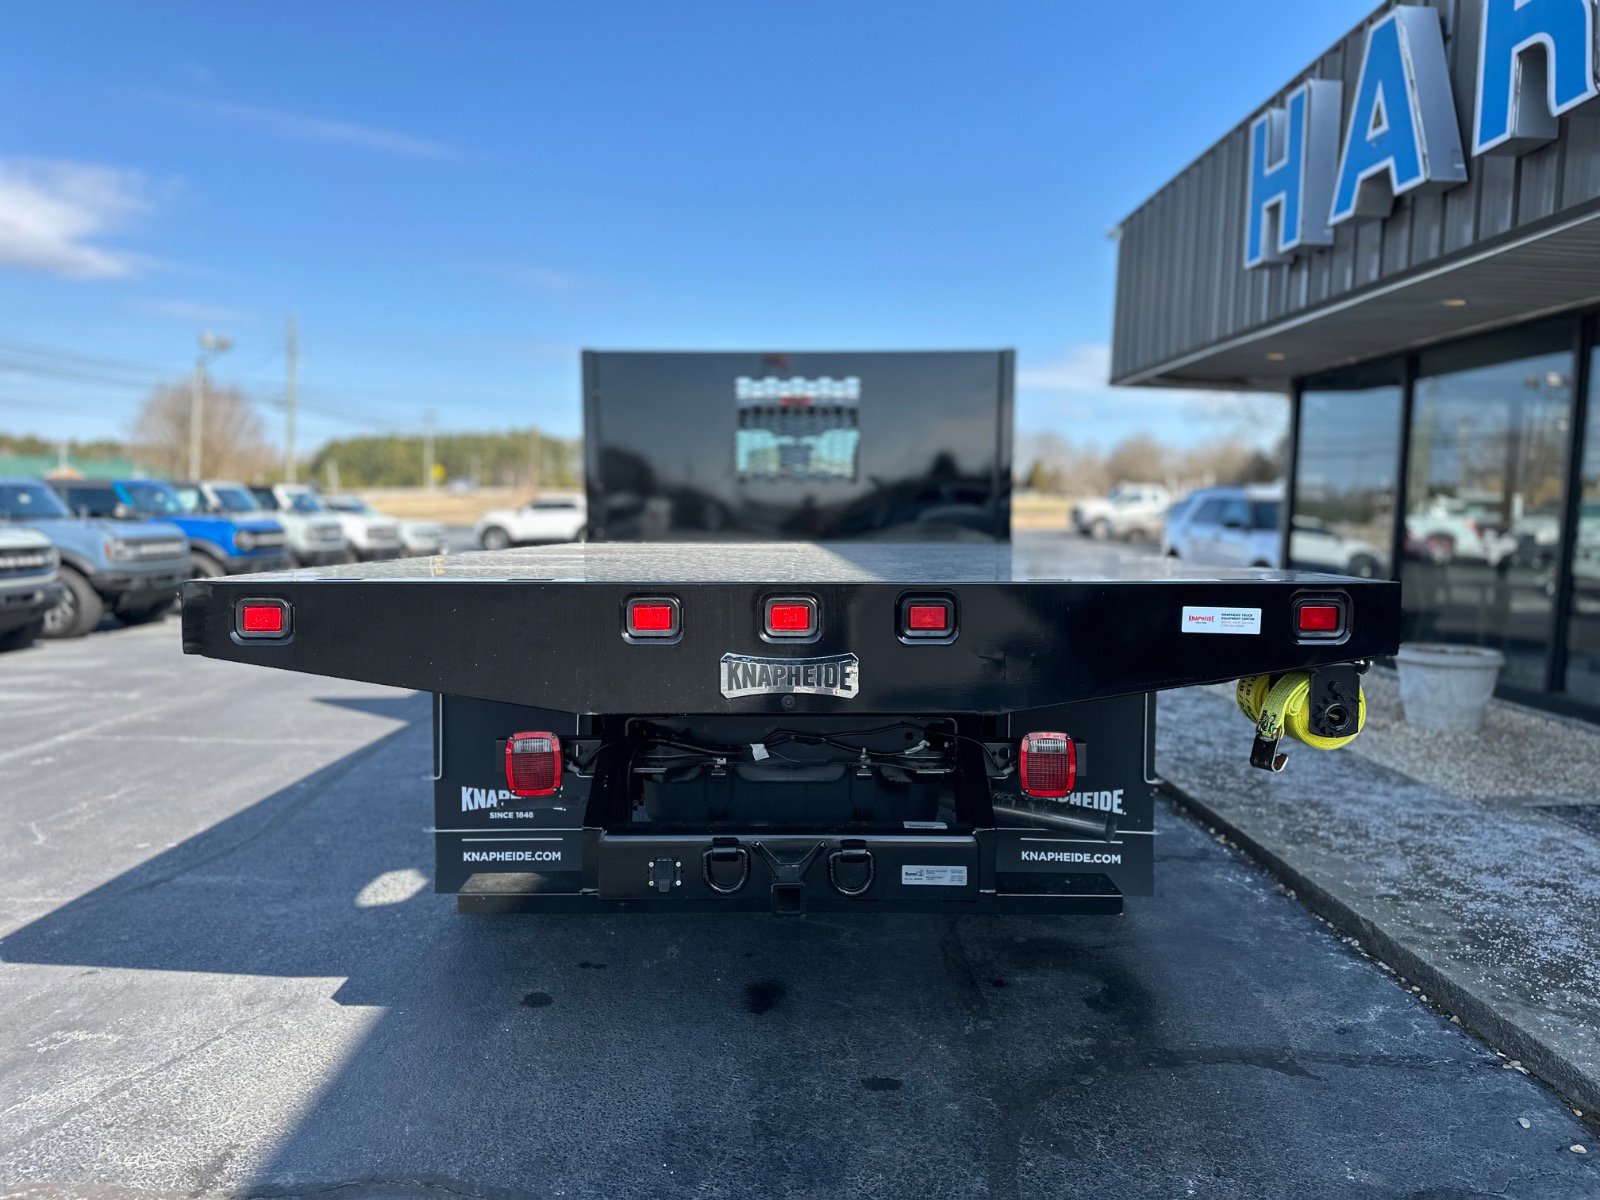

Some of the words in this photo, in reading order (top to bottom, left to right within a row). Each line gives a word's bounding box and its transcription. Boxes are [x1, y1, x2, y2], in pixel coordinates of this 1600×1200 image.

[726, 659, 853, 692] KNAPHEIDE
[489, 811, 514, 819] SINCE
[515, 811, 534, 819] 1848
[463, 851, 562, 862] KNAPHEIDE.COM
[1021, 851, 1122, 864] KNAPHEIDE.COM
